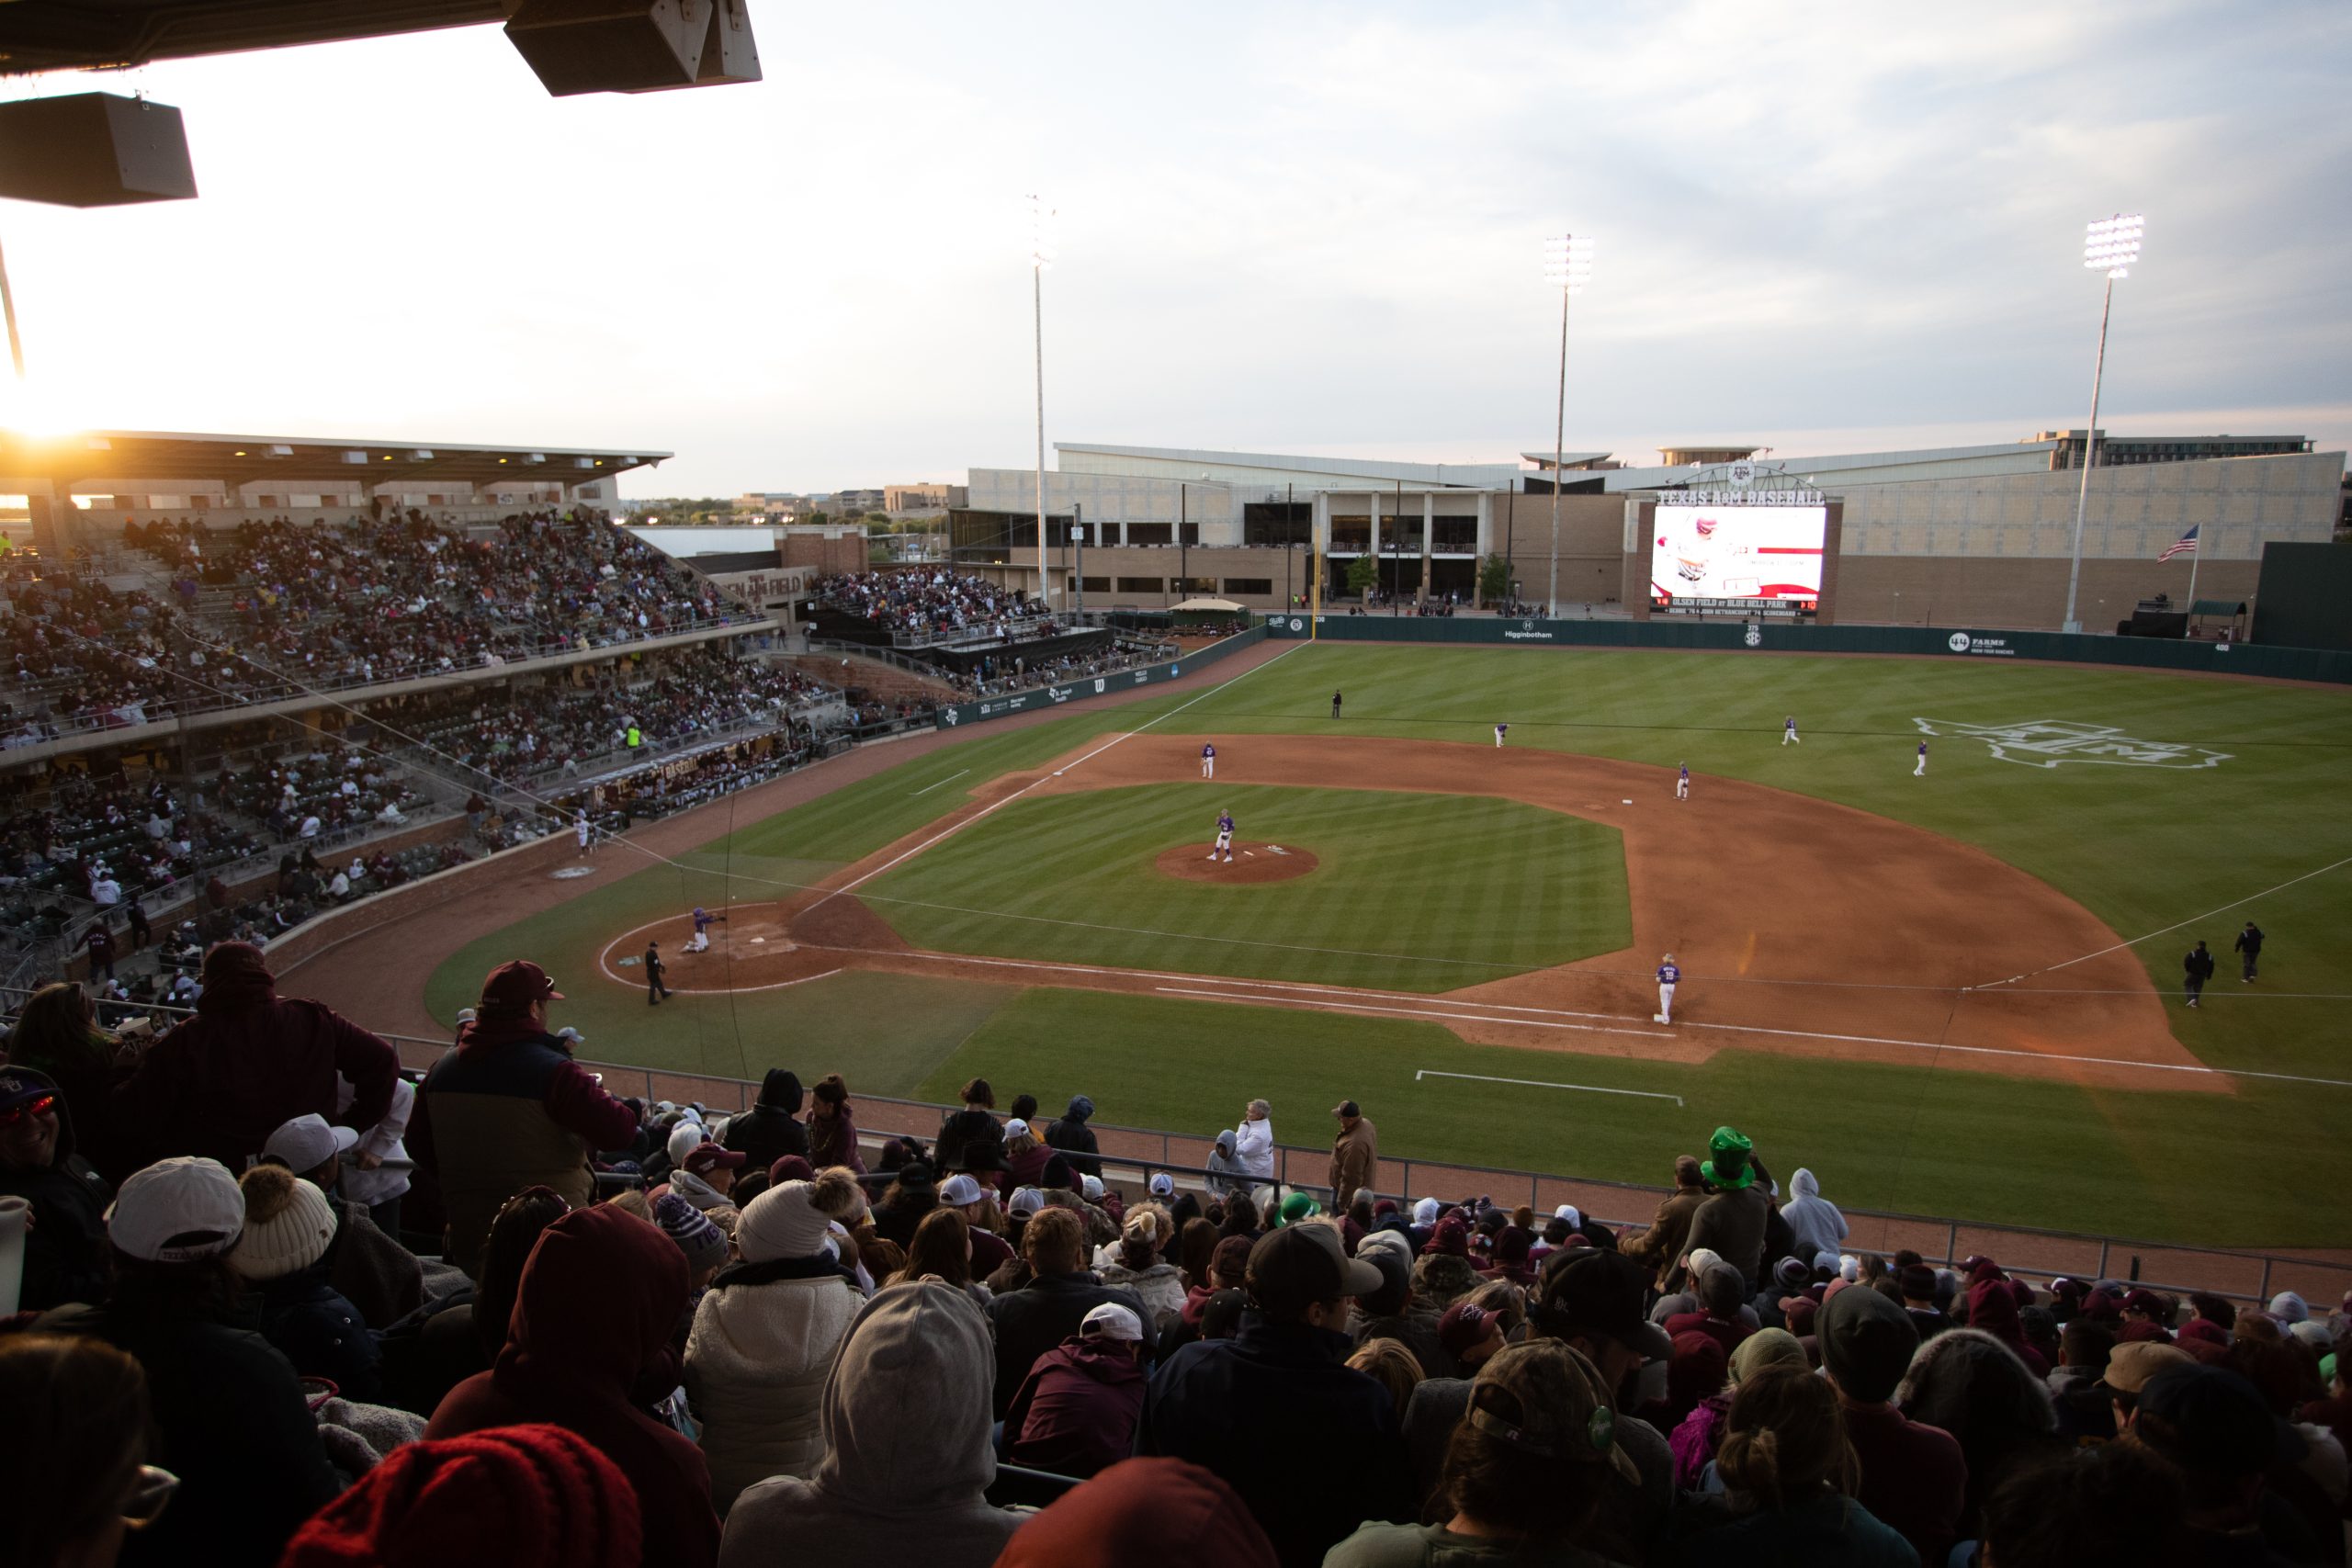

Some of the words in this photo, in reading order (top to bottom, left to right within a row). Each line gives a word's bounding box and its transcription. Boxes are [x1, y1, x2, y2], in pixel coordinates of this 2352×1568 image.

[1657, 491, 1708, 504] TEXAS
[1712, 491, 1742, 505] A&M
[1747, 491, 1826, 505] BASEBALL
[769, 576, 801, 596] FIELD
[1672, 598, 1694, 606] OLSEN
[1696, 598, 1716, 606] FIELD
[1726, 599, 1746, 608] BLUE
[1747, 599, 1765, 608] BELL
[1766, 600, 1786, 609] PARK
[1746, 632, 1760, 644] SEC
[1951, 638, 1968, 647] 44
[2215, 644, 2230, 652] 400
